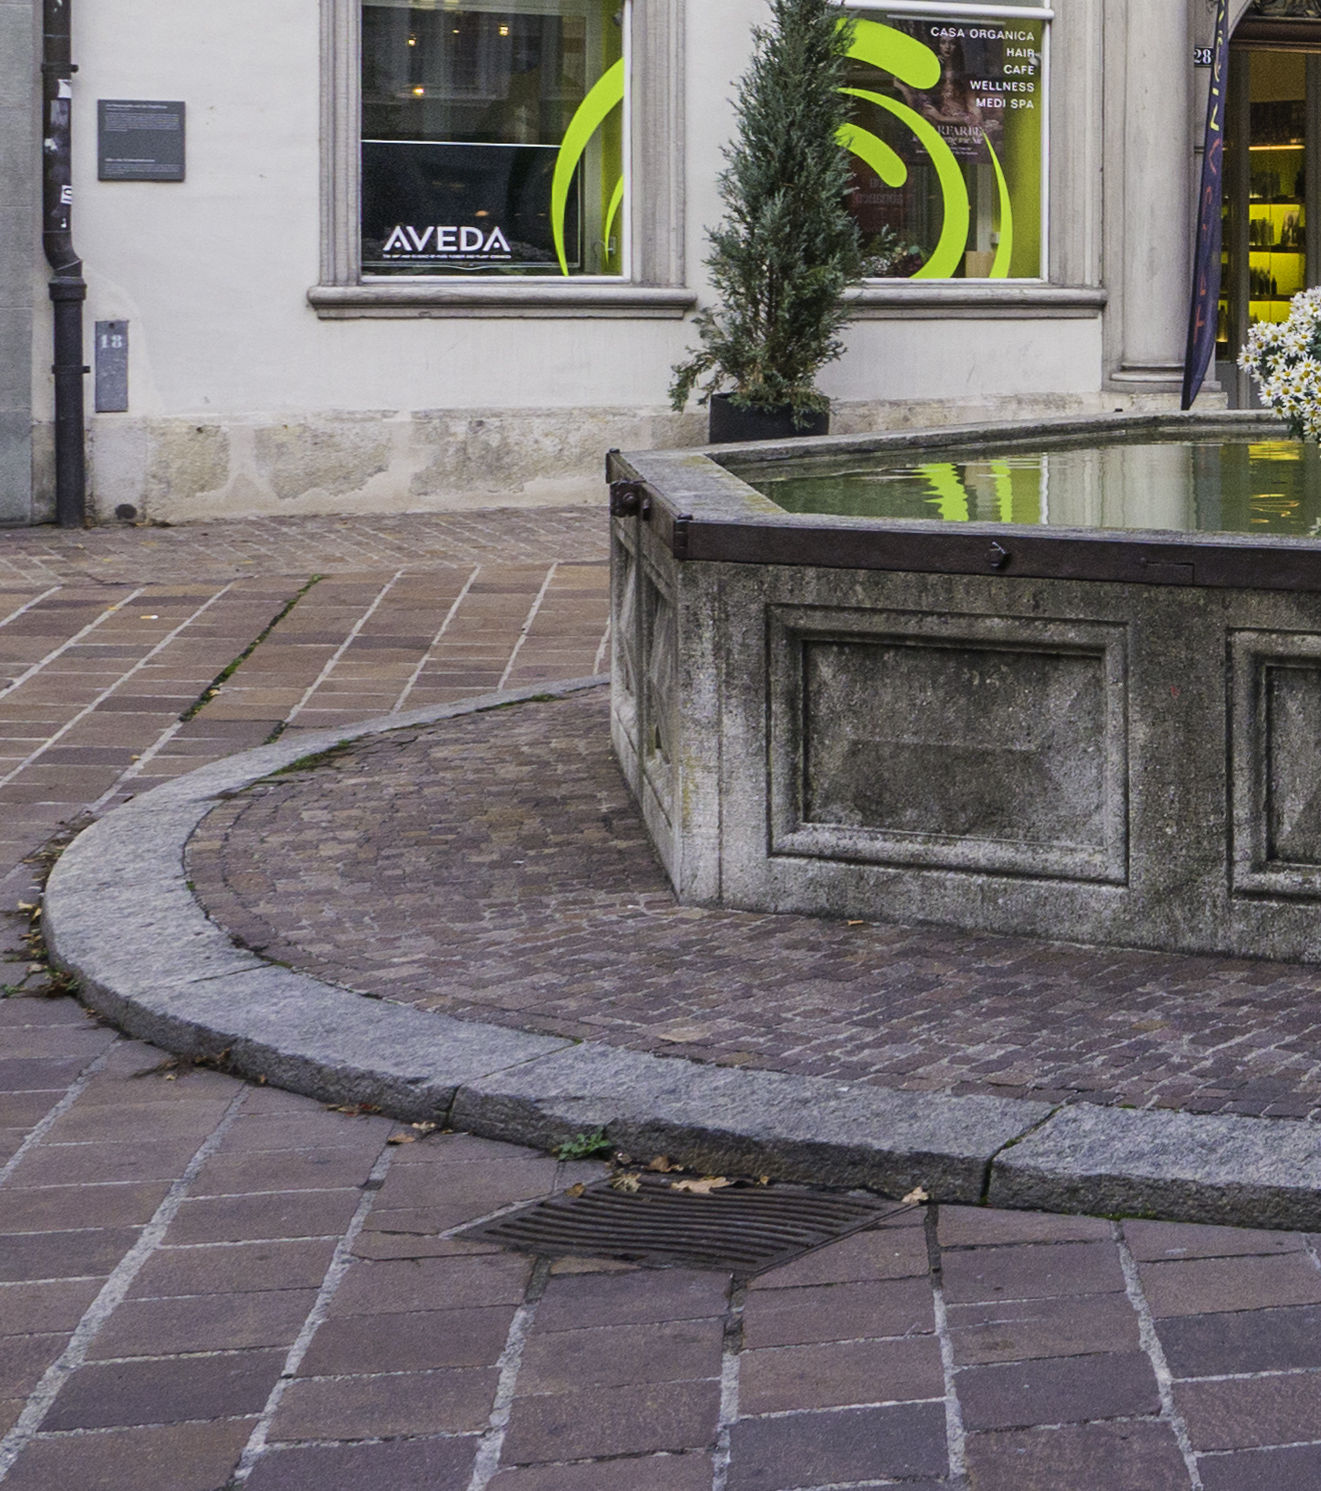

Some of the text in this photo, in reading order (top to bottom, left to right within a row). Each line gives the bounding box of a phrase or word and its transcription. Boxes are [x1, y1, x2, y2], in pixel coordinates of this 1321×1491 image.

[931, 27, 1034, 41] CASA ORGANICA
[1007, 48, 1034, 57] HAIR
[1194, 49, 1212, 64] 28
[1004, 65, 1034, 75] CAFE
[970, 80, 1034, 92] WELLNESS
[976, 98, 1034, 108] MEDI SPA
[383, 226, 511, 251] AVEDA
[101, 334, 122, 348] 18
